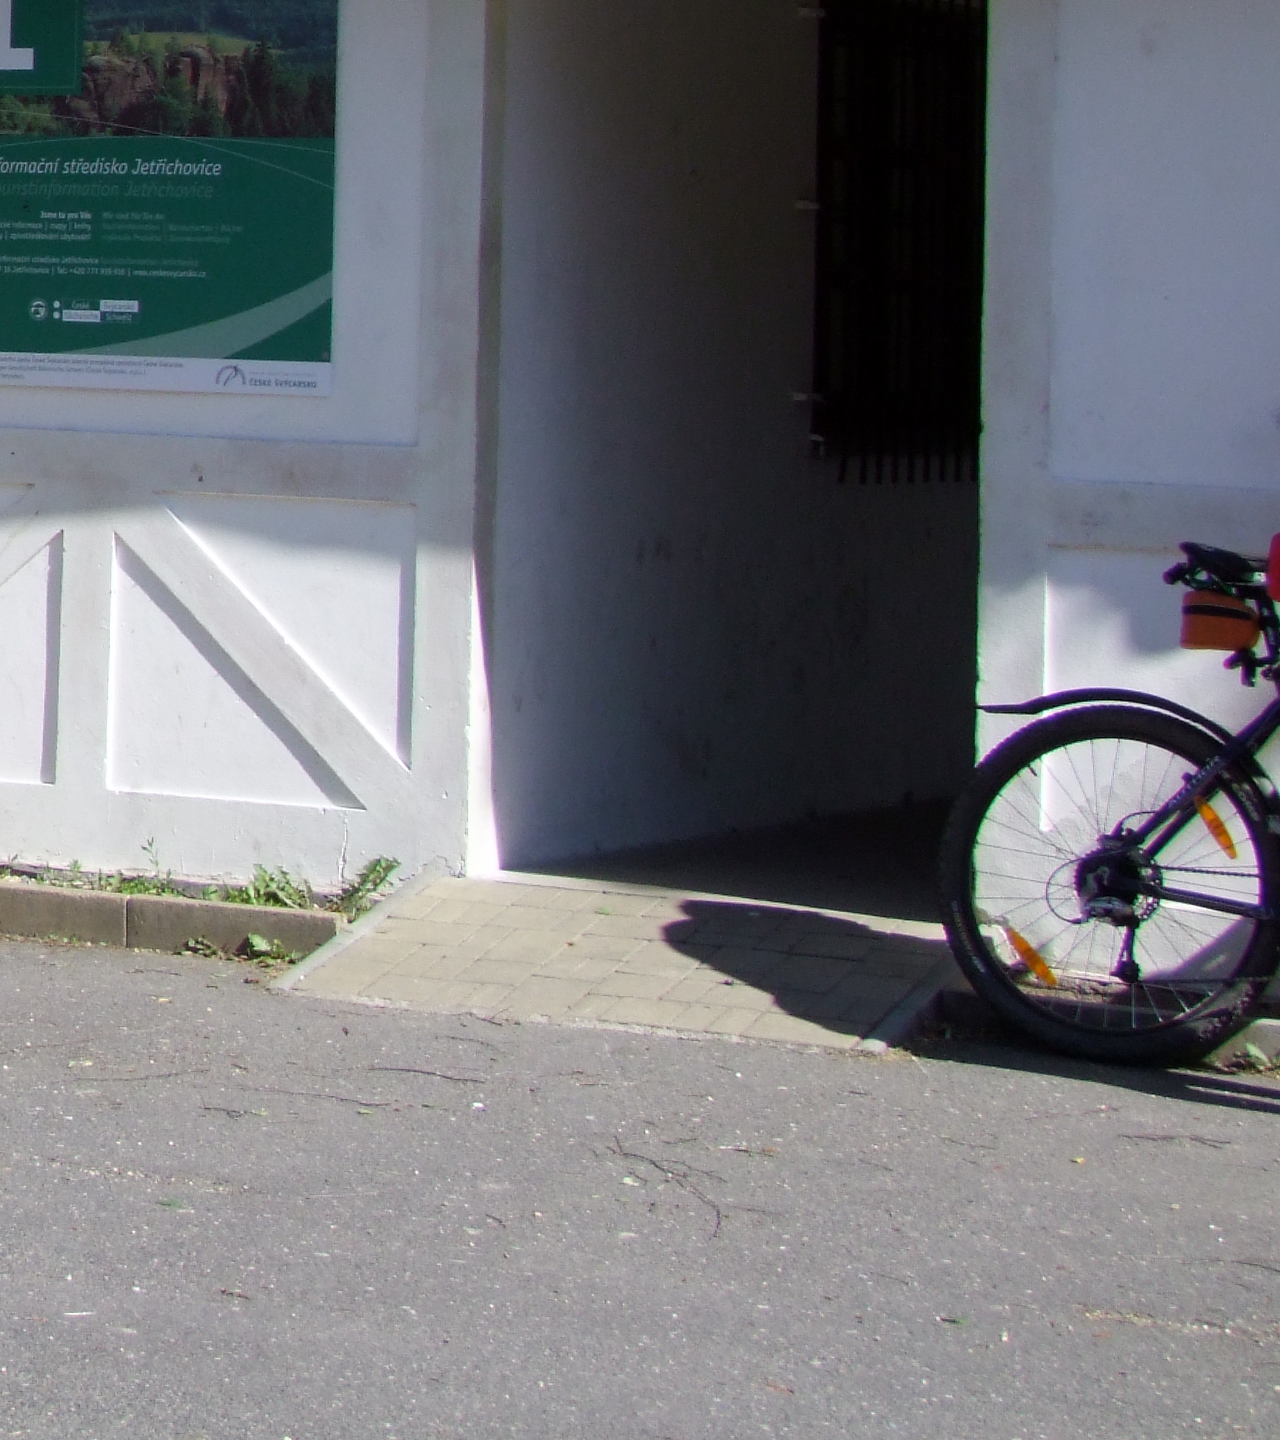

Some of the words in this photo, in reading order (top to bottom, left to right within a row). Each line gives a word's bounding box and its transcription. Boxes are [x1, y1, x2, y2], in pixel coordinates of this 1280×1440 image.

[62, 157, 128, 175] středisko
[132, 158, 222, 176] Jetřichovice
[124, 180, 214, 199] Jetřichovice
